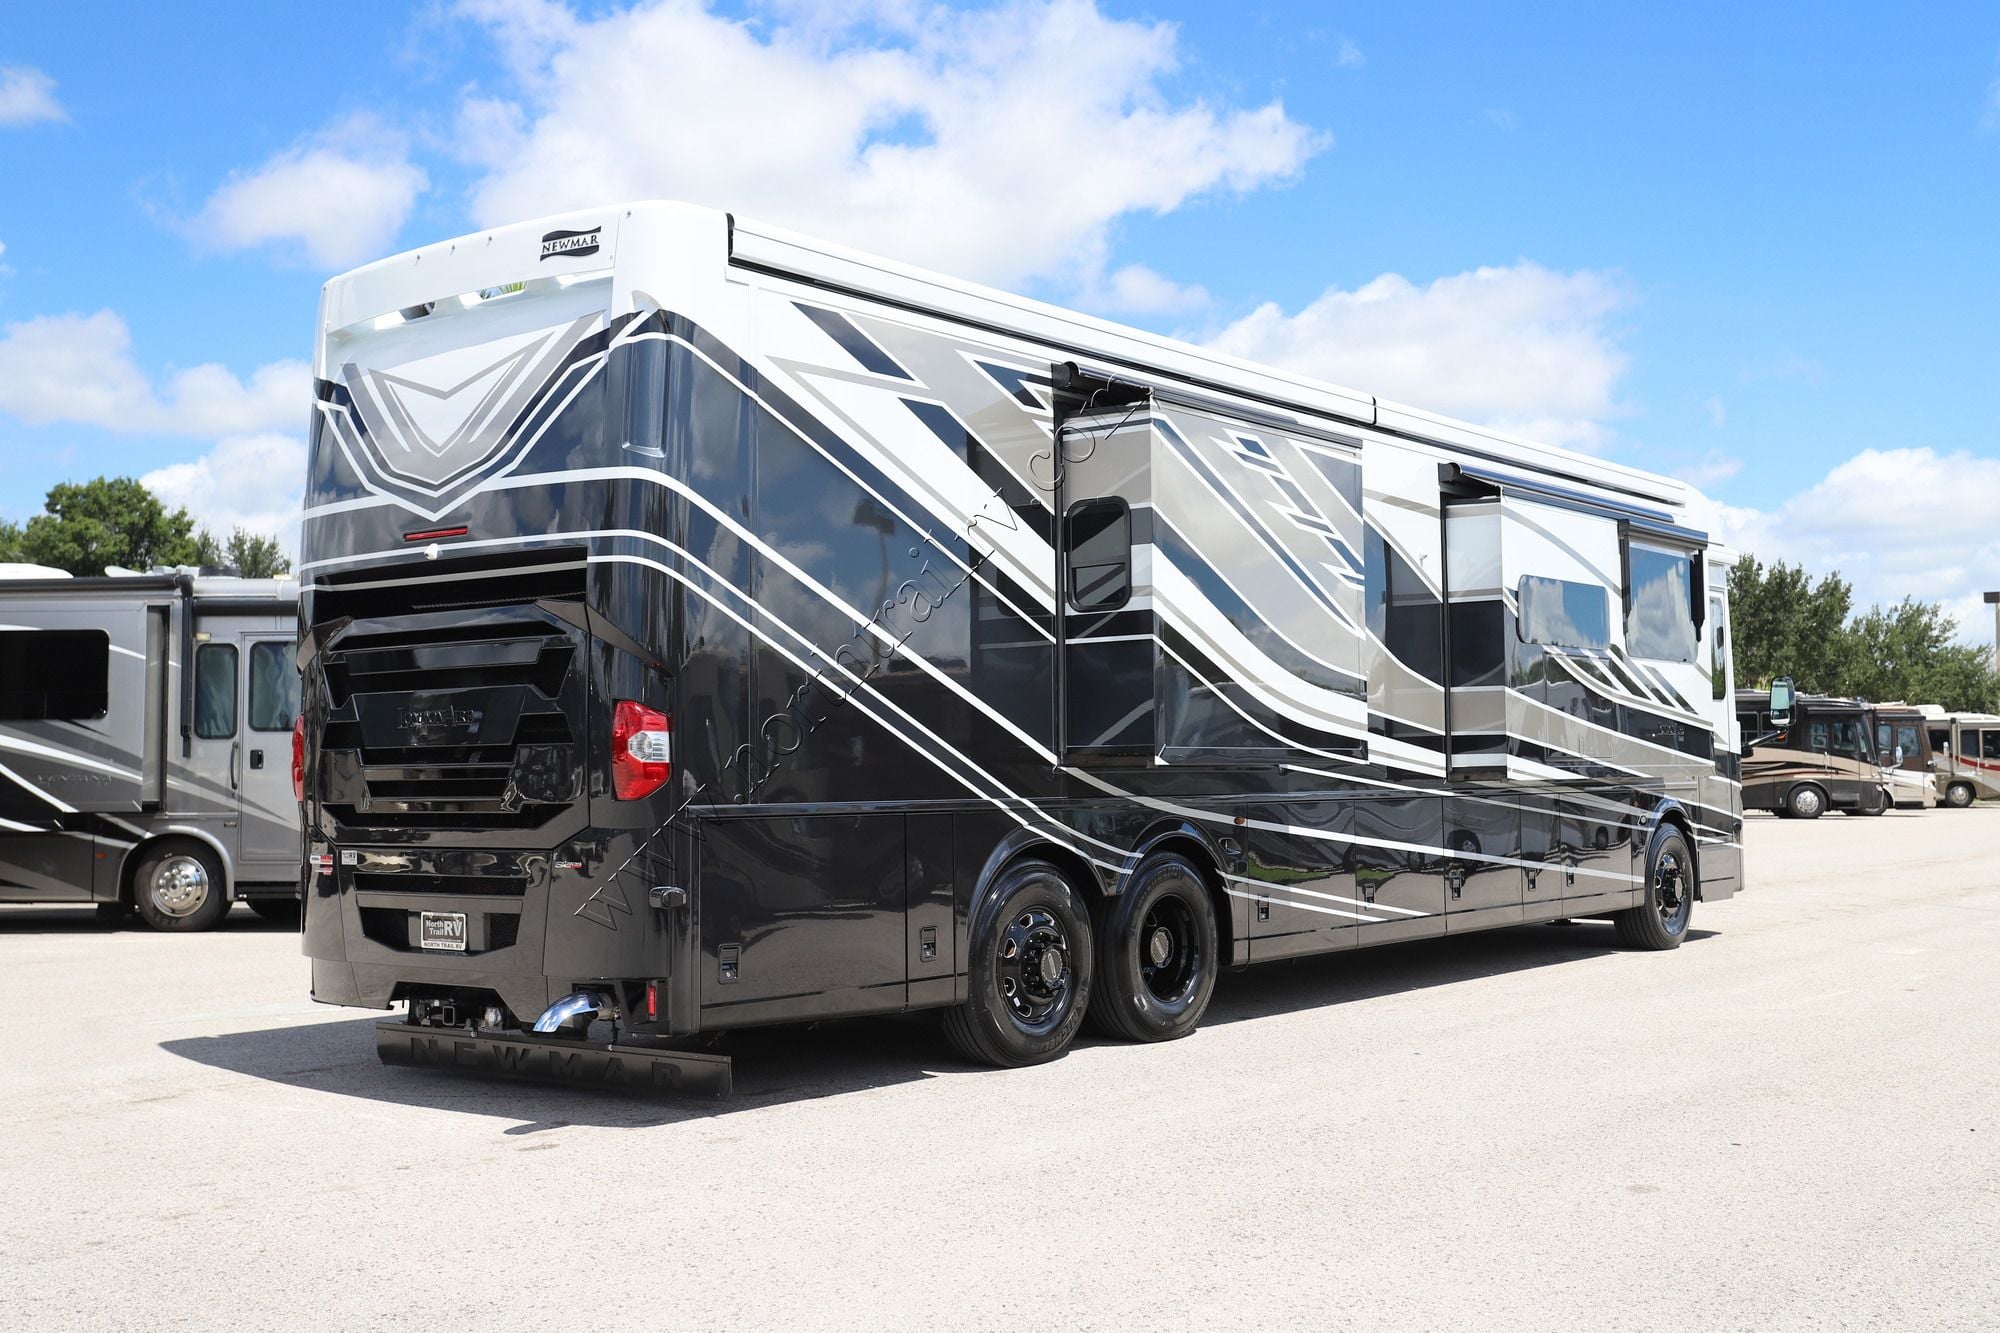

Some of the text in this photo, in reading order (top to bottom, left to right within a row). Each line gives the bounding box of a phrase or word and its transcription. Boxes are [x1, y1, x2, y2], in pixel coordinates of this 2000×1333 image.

[542, 234, 598, 253] NEWMAR
[426, 919, 443, 928] North
[443, 920, 462, 936] RV
[429, 928, 443, 936] Trail
[410, 1037, 684, 1088] NEWMAR
